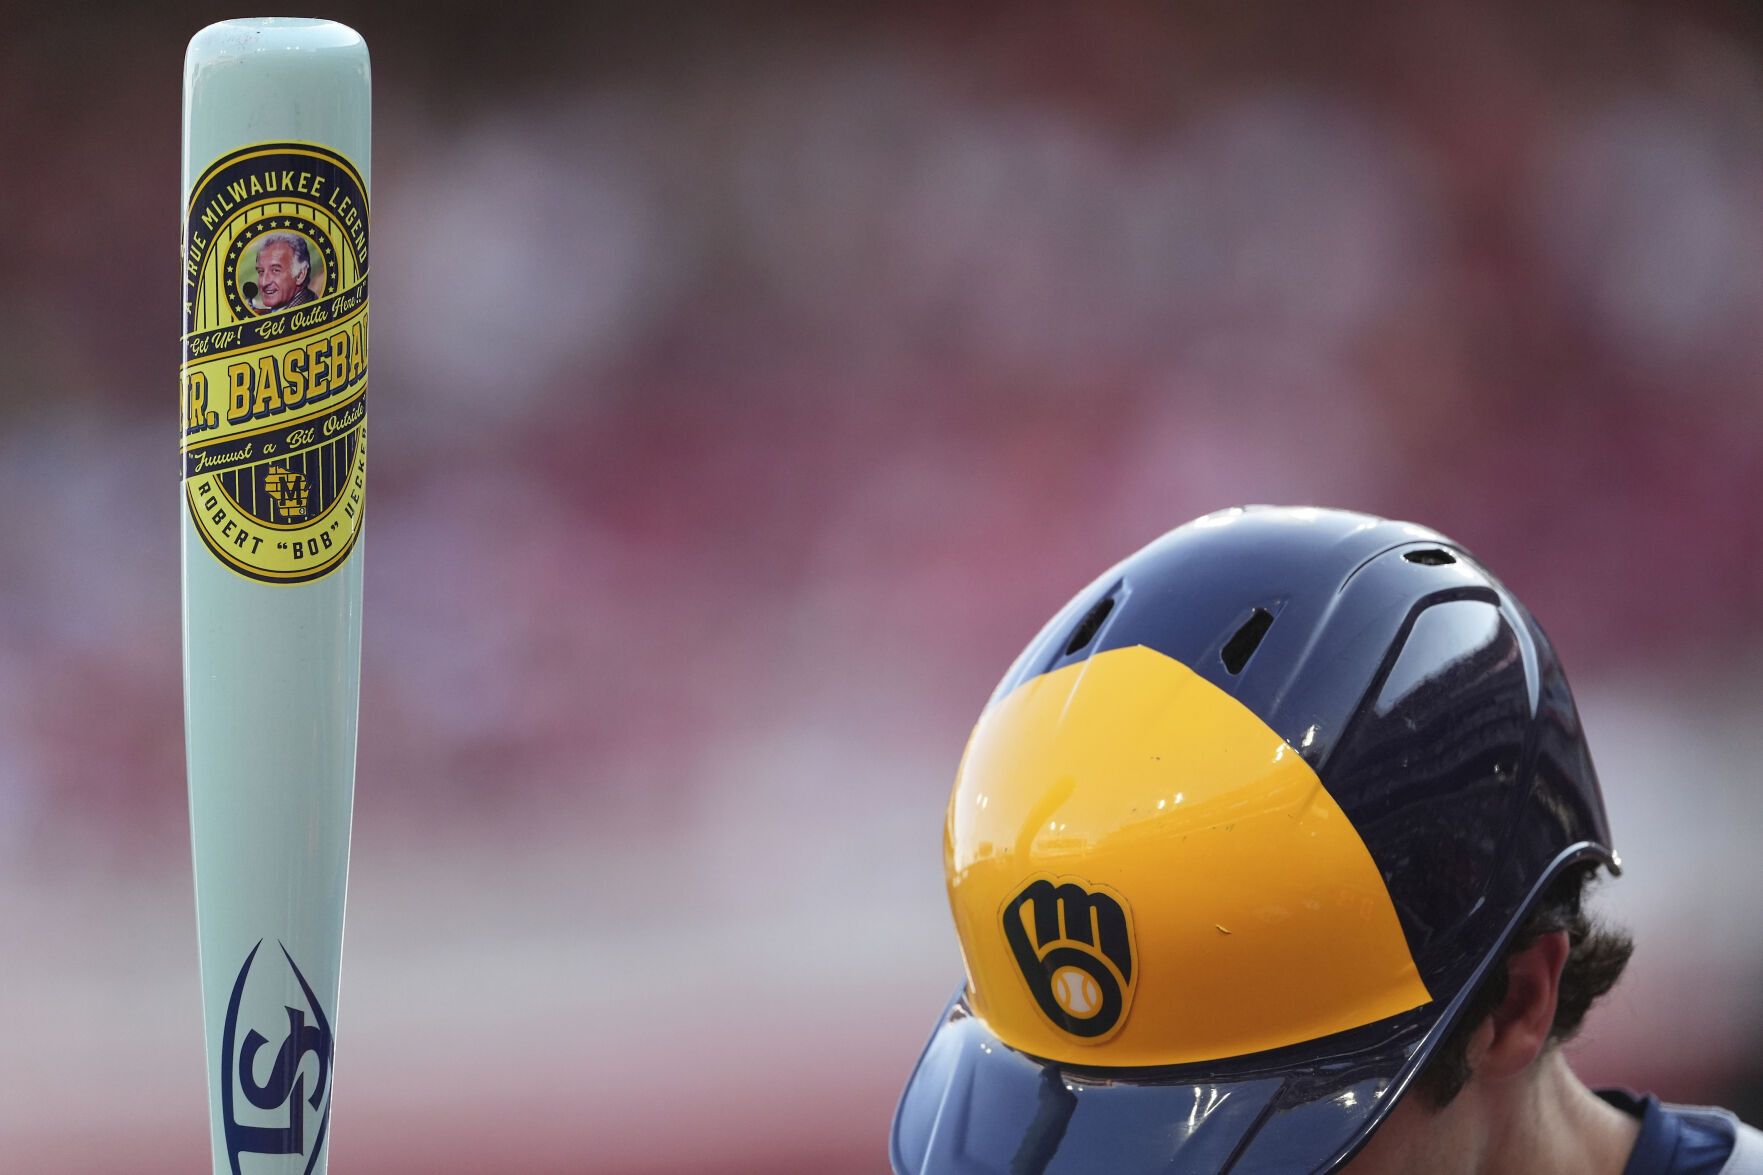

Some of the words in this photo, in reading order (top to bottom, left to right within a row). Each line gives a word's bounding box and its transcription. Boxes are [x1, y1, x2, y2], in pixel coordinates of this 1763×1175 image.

[201, 171, 326, 231] MILWAUKEE
[328, 187, 368, 264] LEGEND
[211, 325, 243, 349] Up!
[254, 320, 285, 340] Get
[290, 304, 329, 331] Outta
[262, 442, 277, 454] a
[285, 426, 316, 449] Bit
[198, 480, 264, 555] ROBERT
[276, 520, 340, 560] “BOB”
